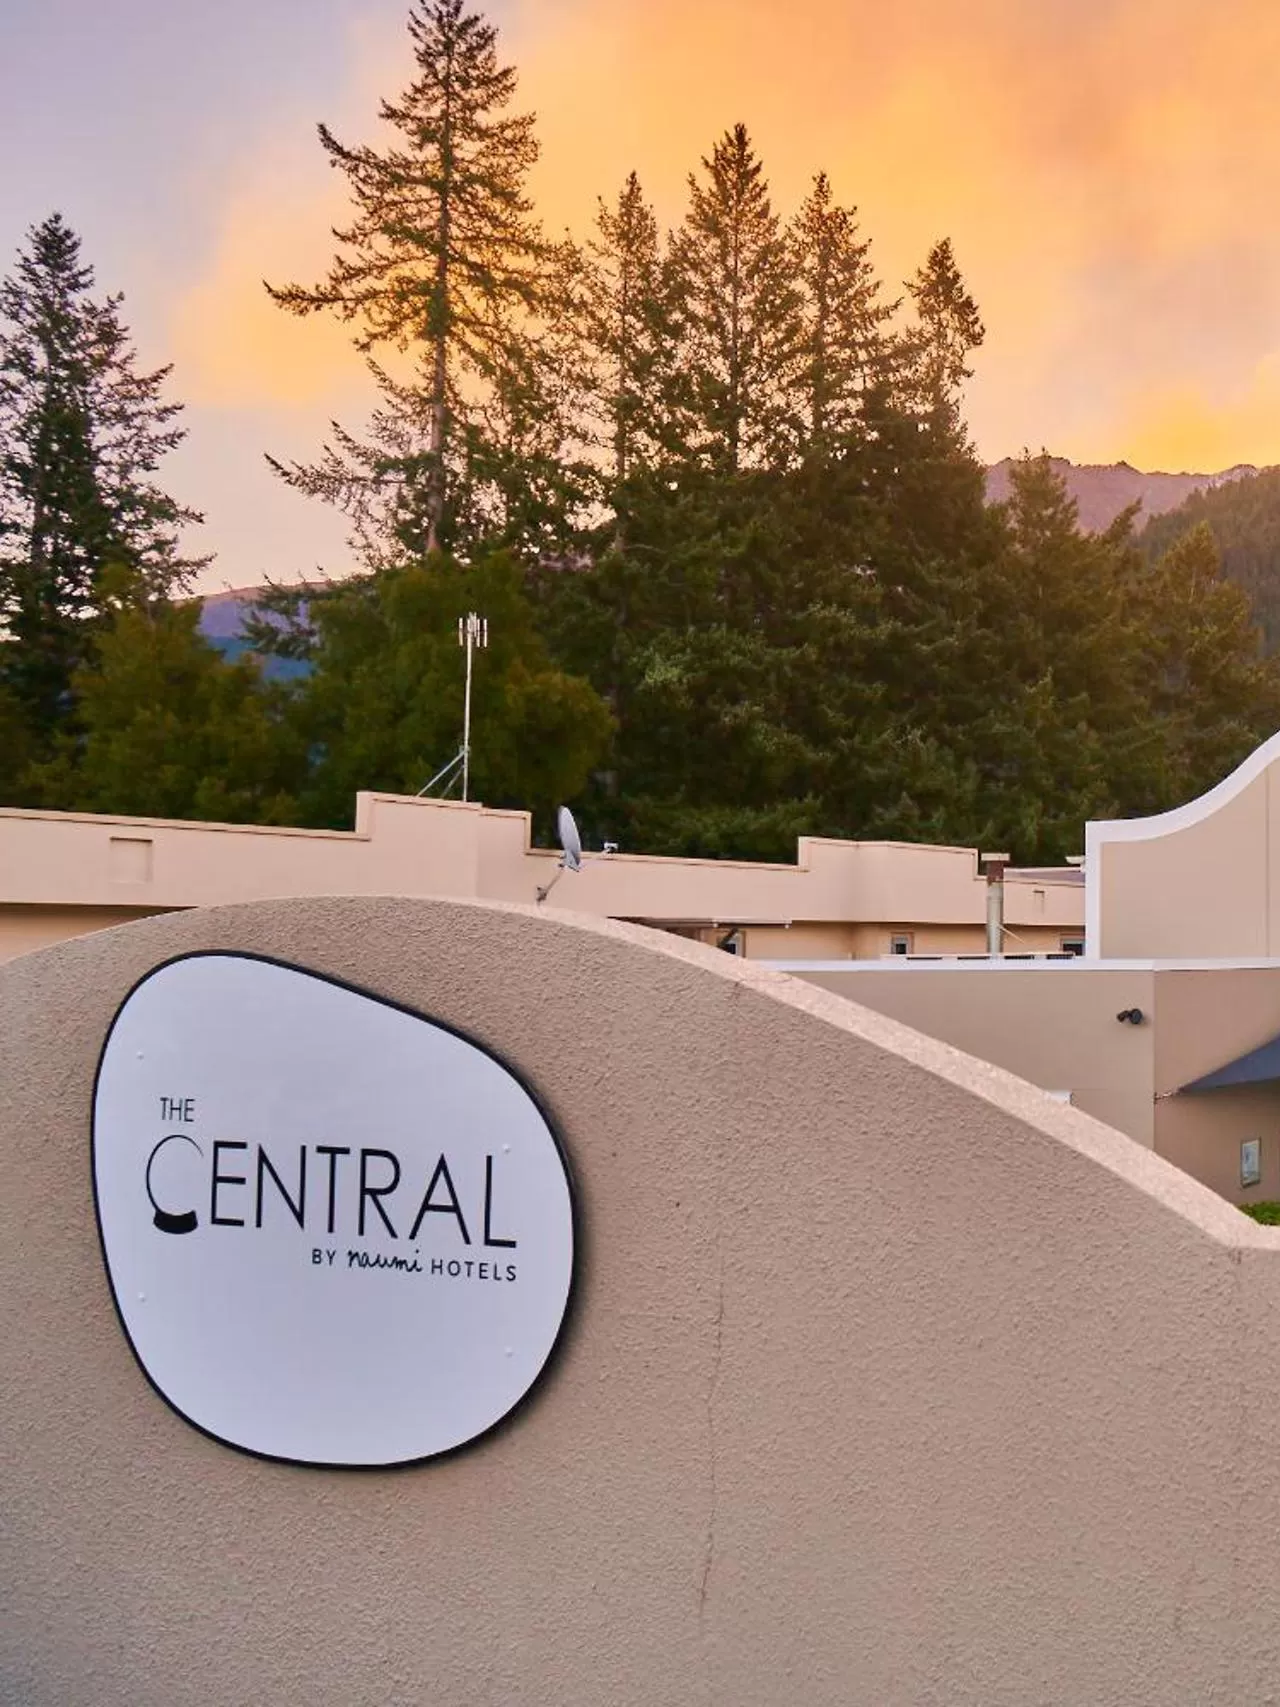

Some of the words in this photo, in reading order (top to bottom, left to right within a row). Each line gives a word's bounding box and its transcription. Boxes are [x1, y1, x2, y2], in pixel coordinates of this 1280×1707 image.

[159, 1096, 196, 1123] THE
[146, 1134, 518, 1249] CENTRAL
[311, 1248, 337, 1266] BY
[346, 1248, 424, 1273] naumi
[430, 1258, 517, 1282] HOTELS
